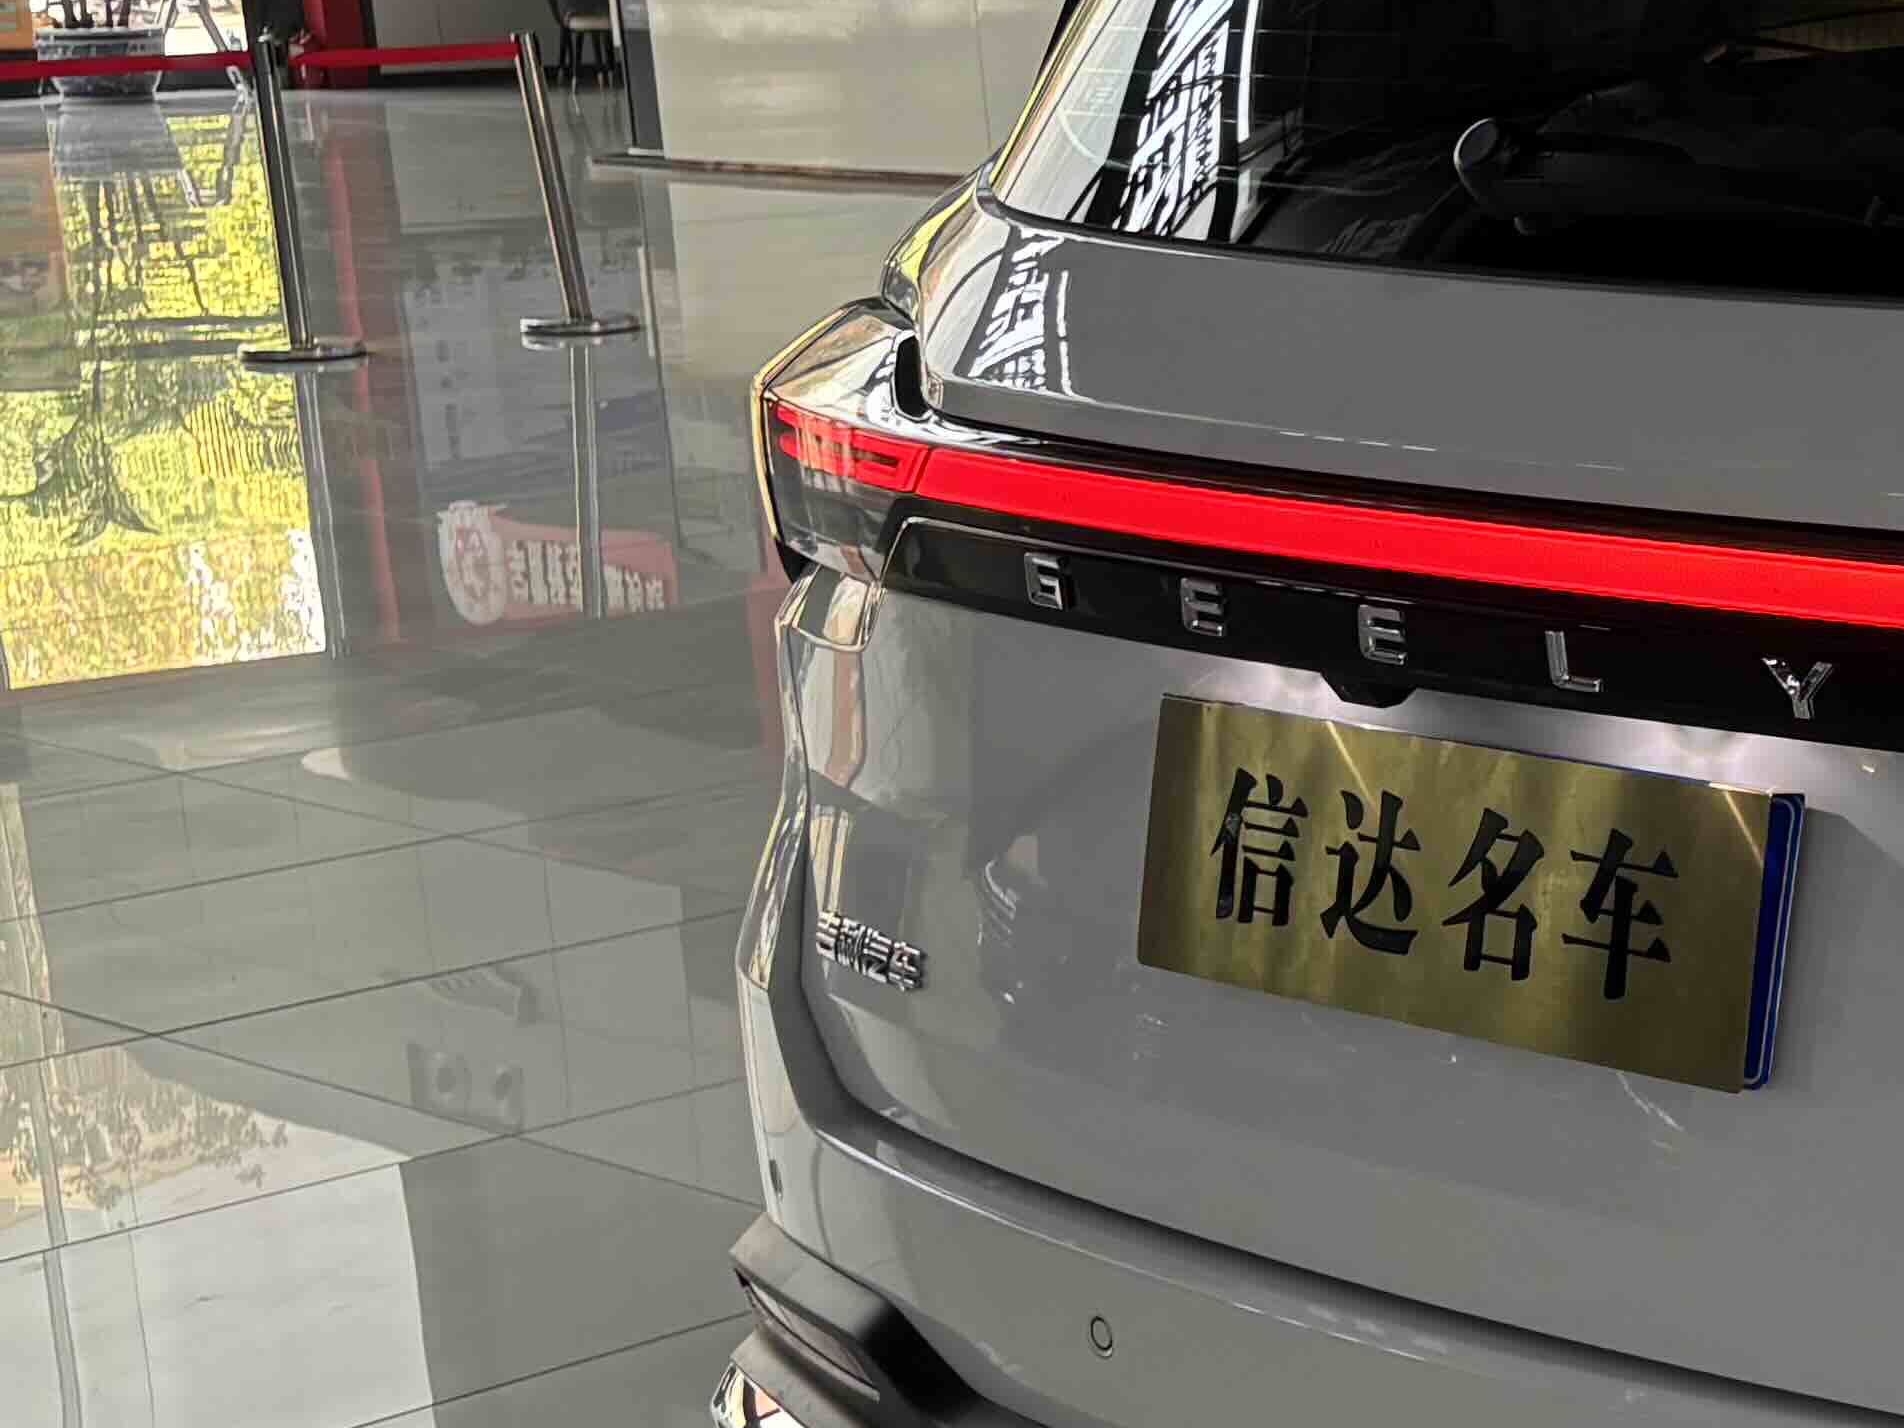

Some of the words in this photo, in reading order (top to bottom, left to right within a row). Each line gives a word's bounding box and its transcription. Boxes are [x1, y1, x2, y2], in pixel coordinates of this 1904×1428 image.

[1024, 551, 1833, 719] GEELY
[1209, 766, 1679, 1000] 信达名车
